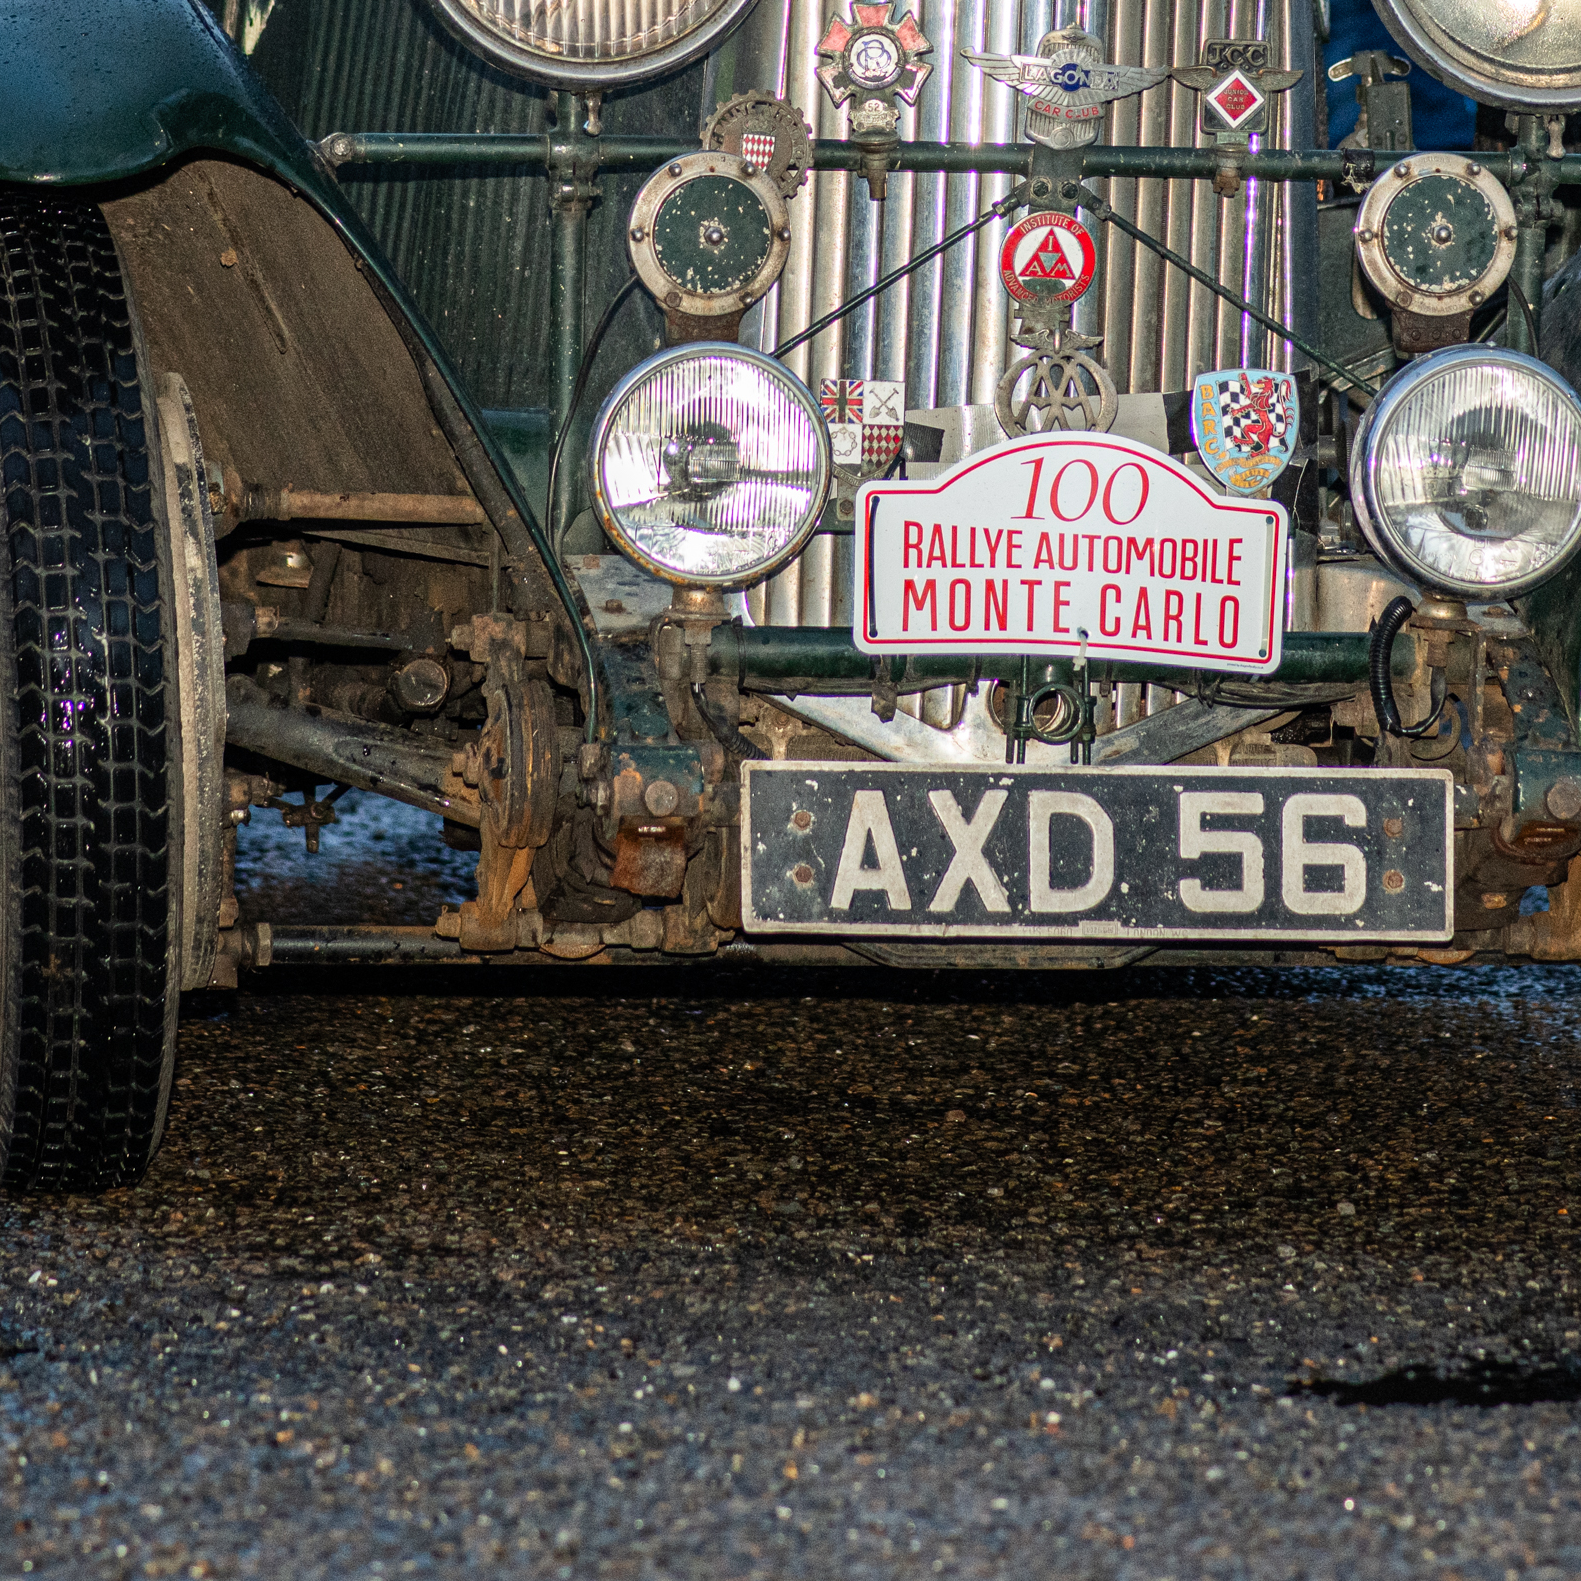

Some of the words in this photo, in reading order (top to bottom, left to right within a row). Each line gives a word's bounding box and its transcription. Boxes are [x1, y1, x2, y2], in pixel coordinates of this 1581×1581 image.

[1024, 65, 1119, 90] LAGONDA
[1208, 45, 1265, 66] JCC
[1034, 100, 1060, 116] CAR
[1020, 214, 1070, 234] INSTITUTE
[1070, 224, 1085, 236] OF
[1010, 456, 1149, 526] 100
[903, 520, 1023, 569] RALLYE
[1033, 531, 1243, 586] AUTOMOBILE
[901, 578, 1072, 634] MONTE
[1099, 583, 1240, 649] CARLO
[830, 789, 1116, 913] AXD
[1178, 791, 1367, 915] 56
